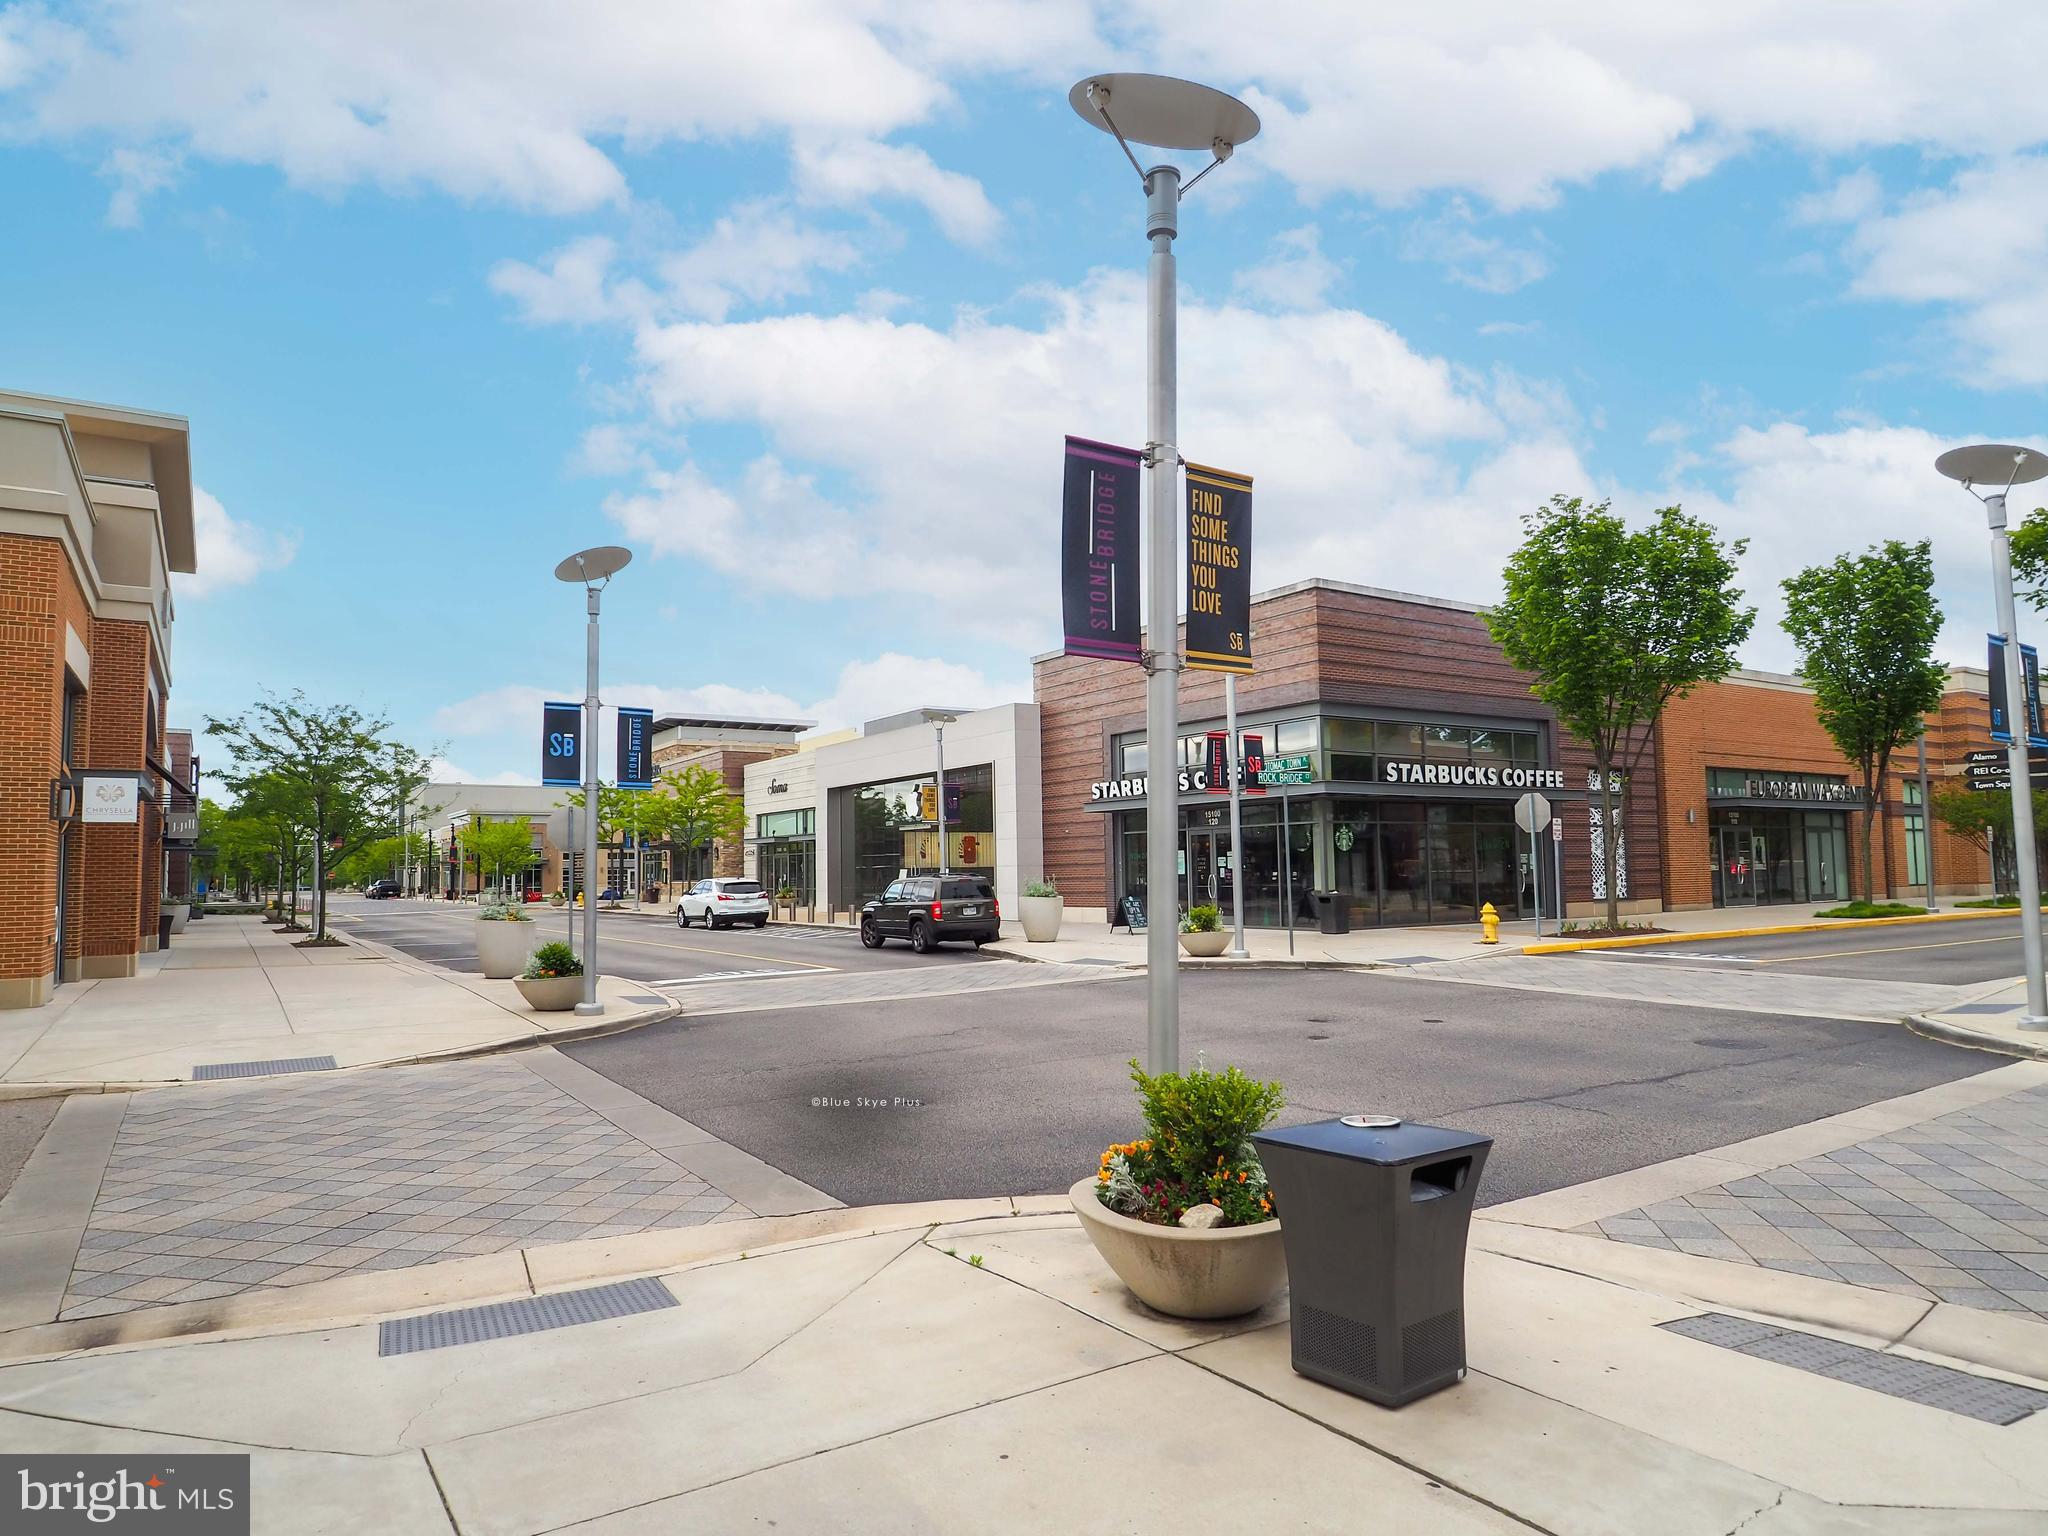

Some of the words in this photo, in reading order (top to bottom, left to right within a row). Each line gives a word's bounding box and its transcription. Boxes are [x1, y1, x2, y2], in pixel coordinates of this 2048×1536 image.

[1192, 489, 1222, 516] FIND
[1192, 515, 1229, 543] SOME
[1089, 472, 1116, 630] STONEBRIDGE
[1191, 539, 1239, 569] THINGS
[1192, 566, 1217, 590] YOU
[1192, 589, 1222, 615] LOVE
[1229, 632, 1244, 651] SB
[549, 732, 574, 757] SB
[628, 718, 642, 779] STONEBRIDGE
[1264, 760, 1285, 772] OTOMAC
[1286, 758, 1302, 769] TOWN
[1972, 753, 1997, 761] Alamo
[1258, 772, 1277, 783] ROCK
[1280, 773, 1303, 783] BRIDGE
[1386, 762, 1498, 786] STARBUCKS
[1502, 768, 1564, 788] COFFEE
[1990, 766, 2010, 774] Co-o
[1748, 780, 1808, 800] EUROPEAN
[1974, 781, 1994, 789] Town
[85, 806, 133, 814] CHRYSELLA
